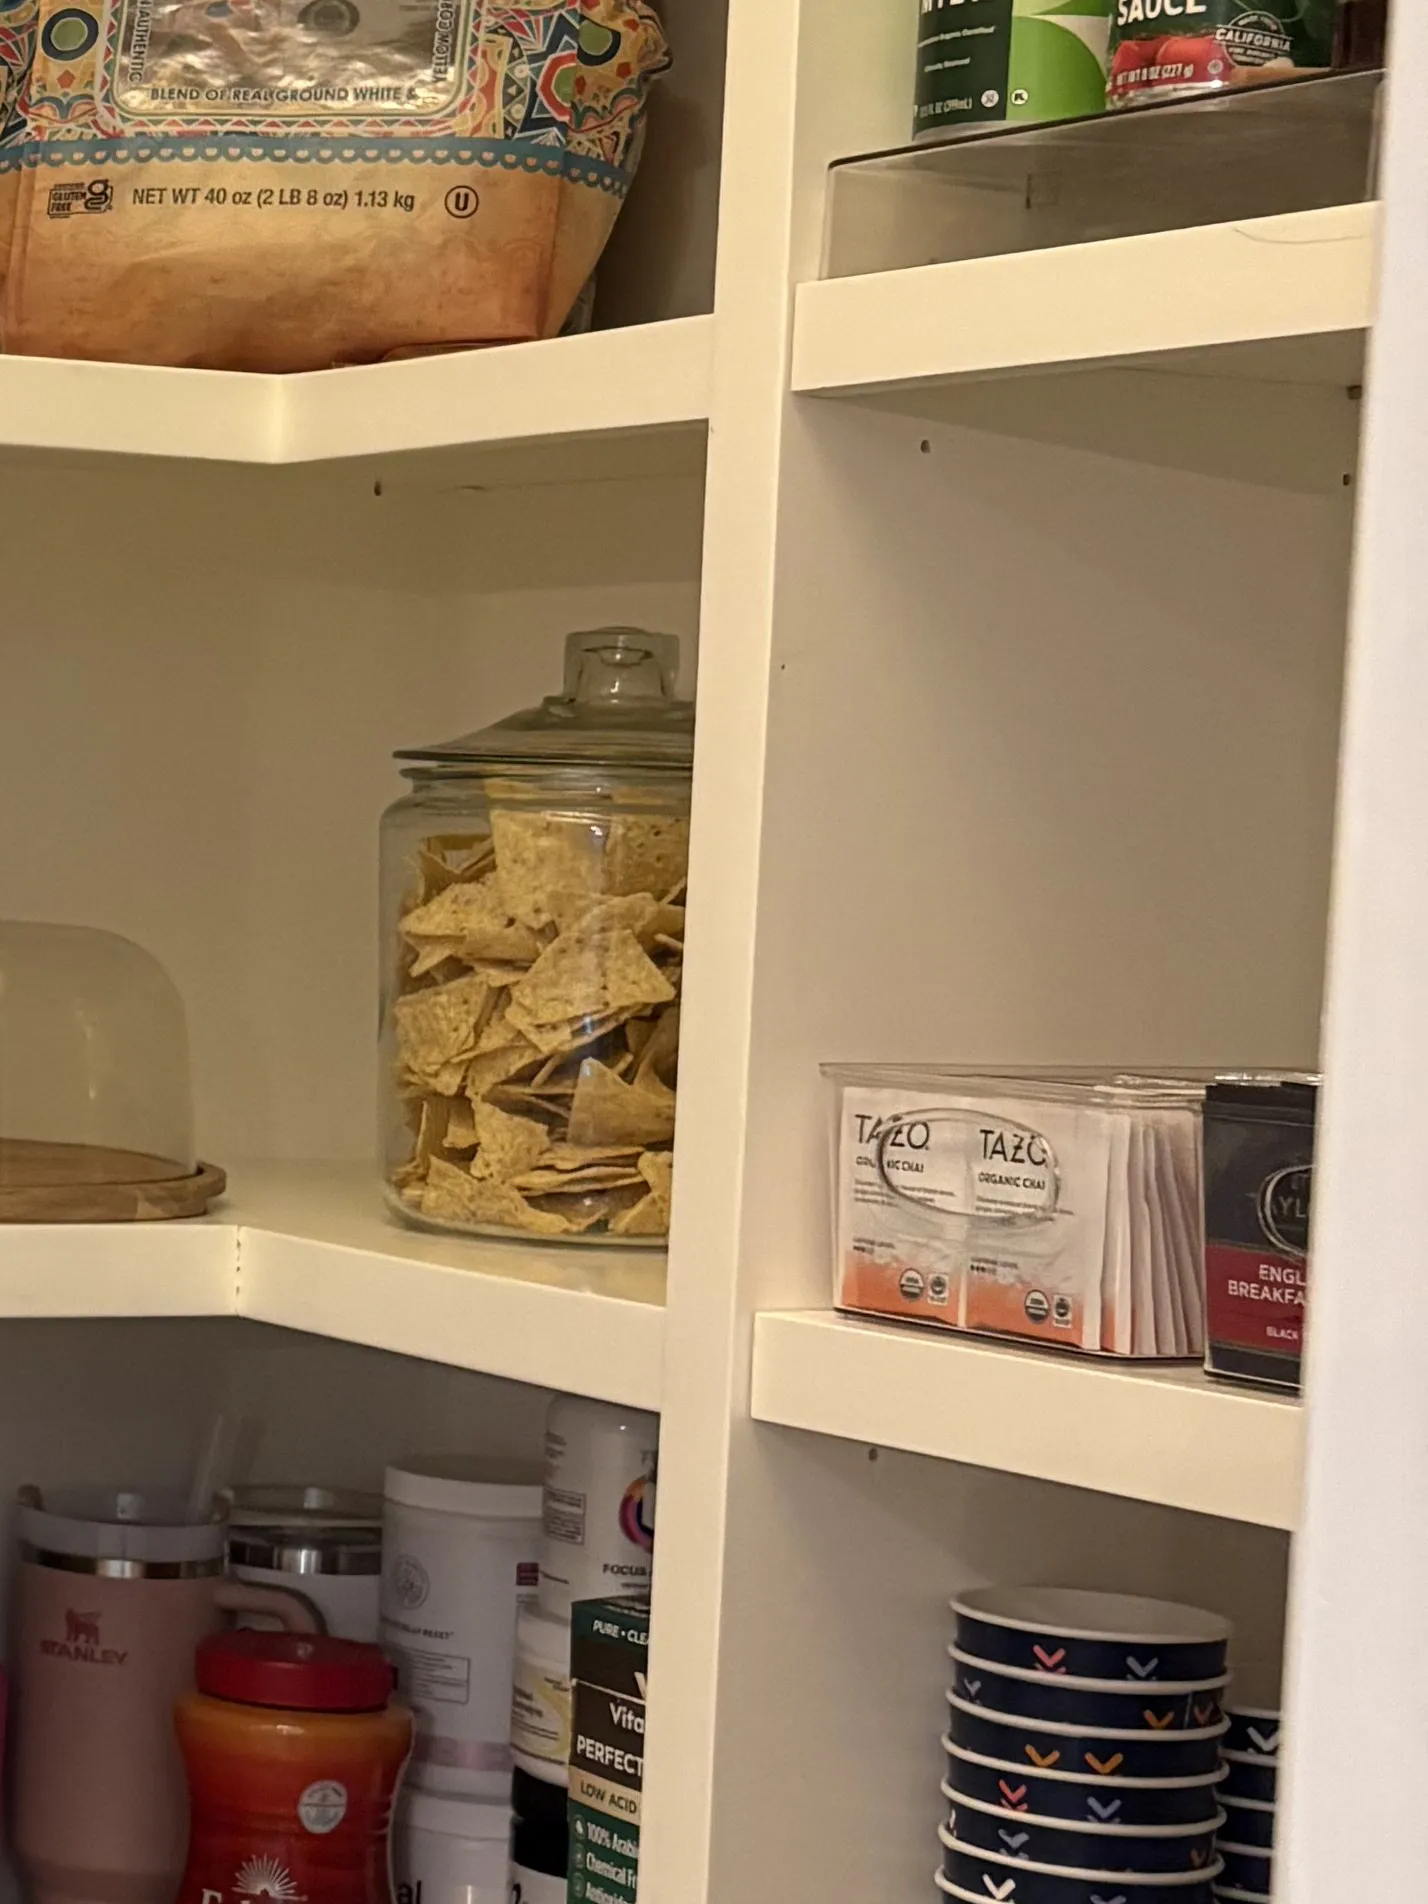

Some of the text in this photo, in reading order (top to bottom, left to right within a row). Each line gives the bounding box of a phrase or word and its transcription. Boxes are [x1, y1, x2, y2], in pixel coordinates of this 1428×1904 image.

[132, 187, 415, 212] NET WT 40 oz (2 LB 8 oz) 1.13 kg
[978, 1172, 1046, 1191] ORGANIC CHAI
[1266, 1326, 1299, 1340] BLACK
[39, 1637, 130, 1667] STANLEY
[575, 1734, 644, 1777] PERFECT
[580, 1780, 638, 1815] LOW ACID
